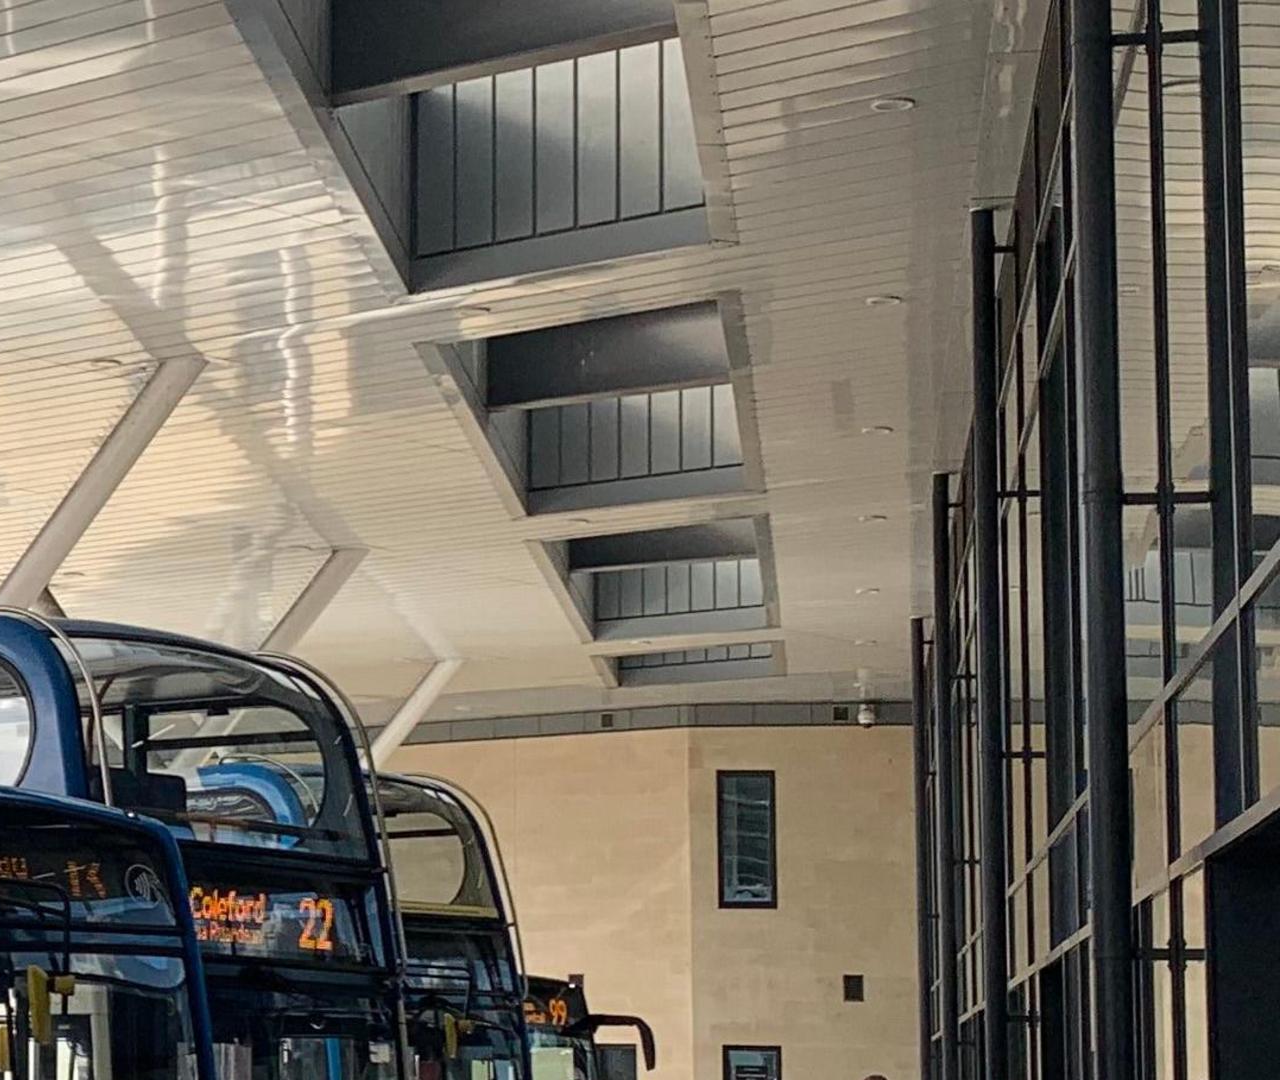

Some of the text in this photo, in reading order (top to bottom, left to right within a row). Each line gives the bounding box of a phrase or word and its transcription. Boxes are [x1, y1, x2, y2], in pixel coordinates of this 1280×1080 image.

[189, 886, 267, 923] Coleford
[298, 897, 334, 951] 22
[549, 998, 568, 1026] 99
